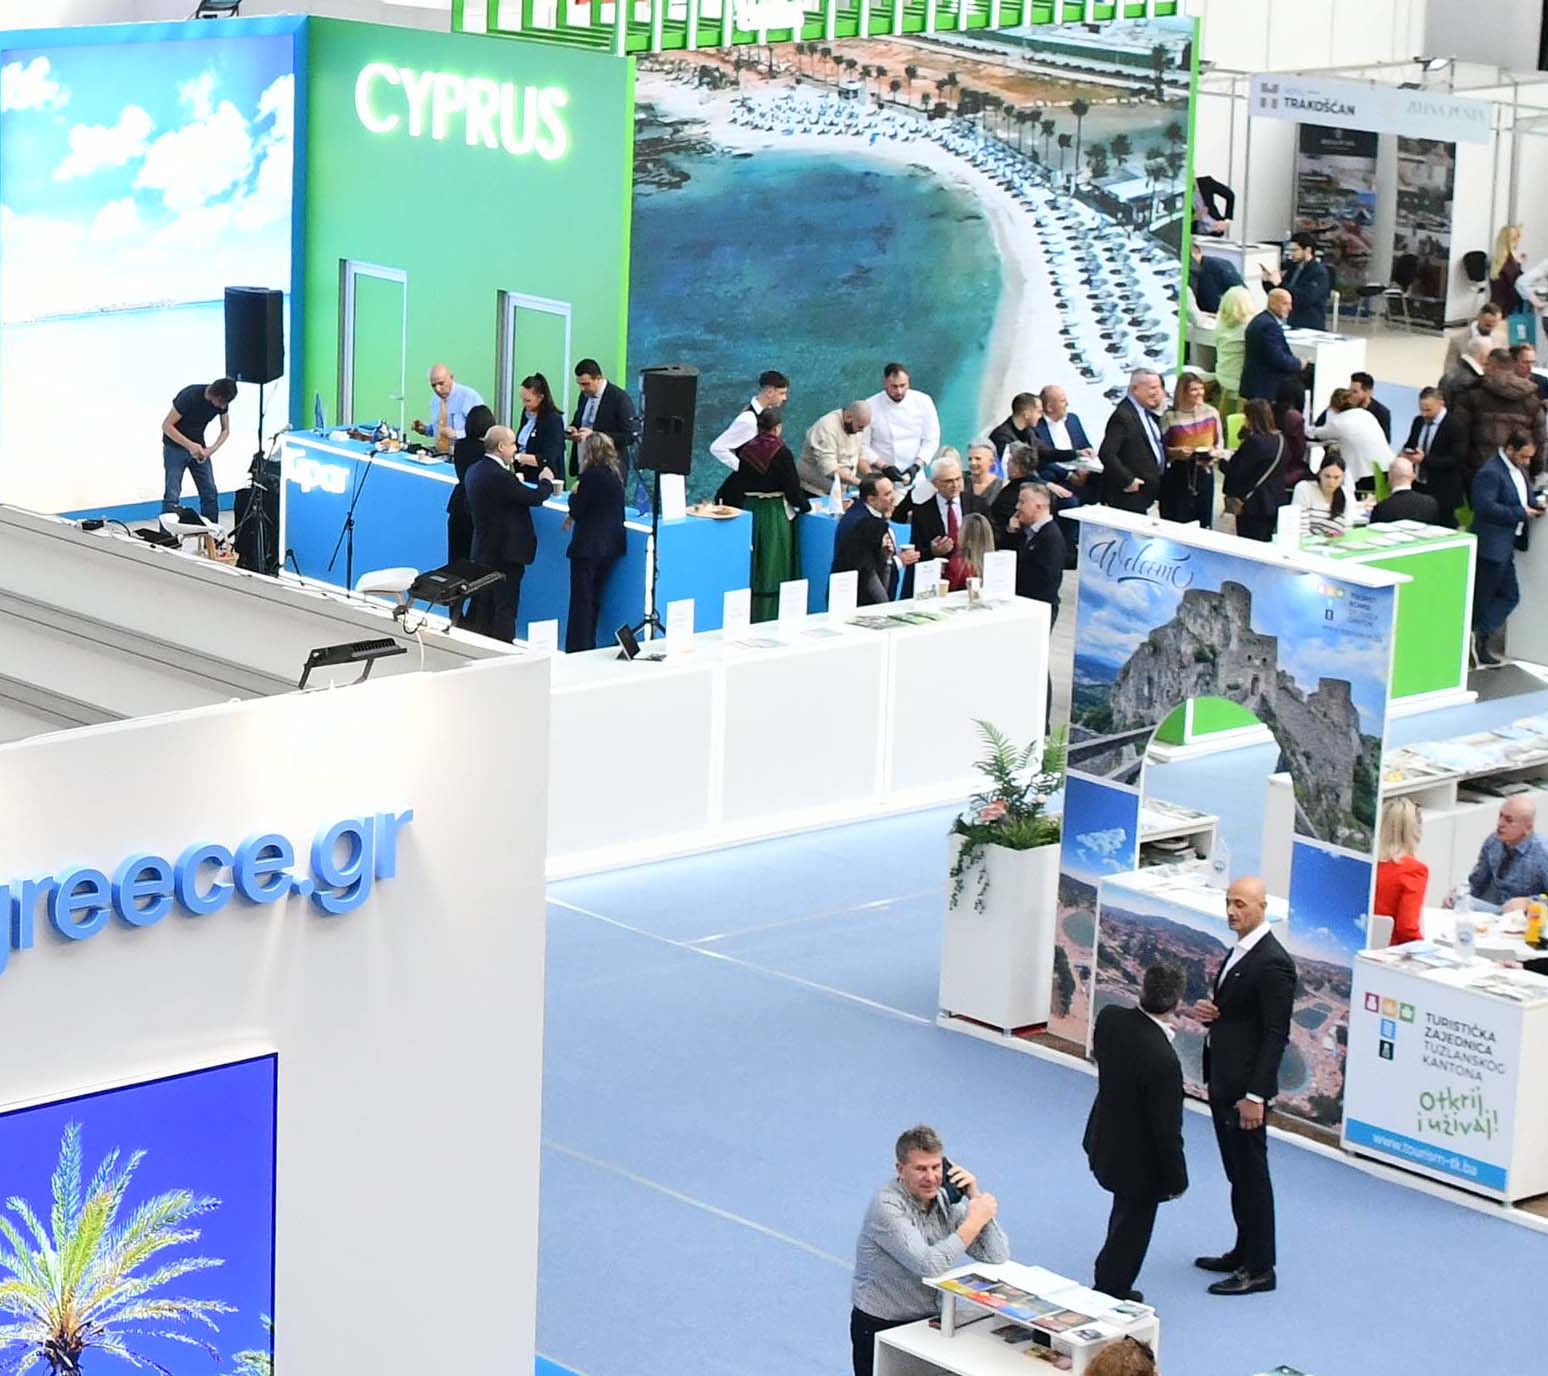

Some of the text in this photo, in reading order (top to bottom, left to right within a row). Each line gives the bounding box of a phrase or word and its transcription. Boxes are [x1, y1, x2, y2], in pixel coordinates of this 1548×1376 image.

[354, 61, 570, 162] CYPRUS
[1284, 96, 1356, 115] TRAKOŠĆAN
[1088, 538, 1195, 589] Welcome
[1423, 1026, 1493, 1056] ZAJEDNICA
[1425, 1011, 1497, 1043] TURISTIČKA
[1422, 1055, 1483, 1081] KANTONA
[1423, 1040, 1507, 1075] TUZLANSKOG
[1418, 1086, 1484, 1117] Otkrij
[1438, 1109, 1509, 1141] uživaj!
